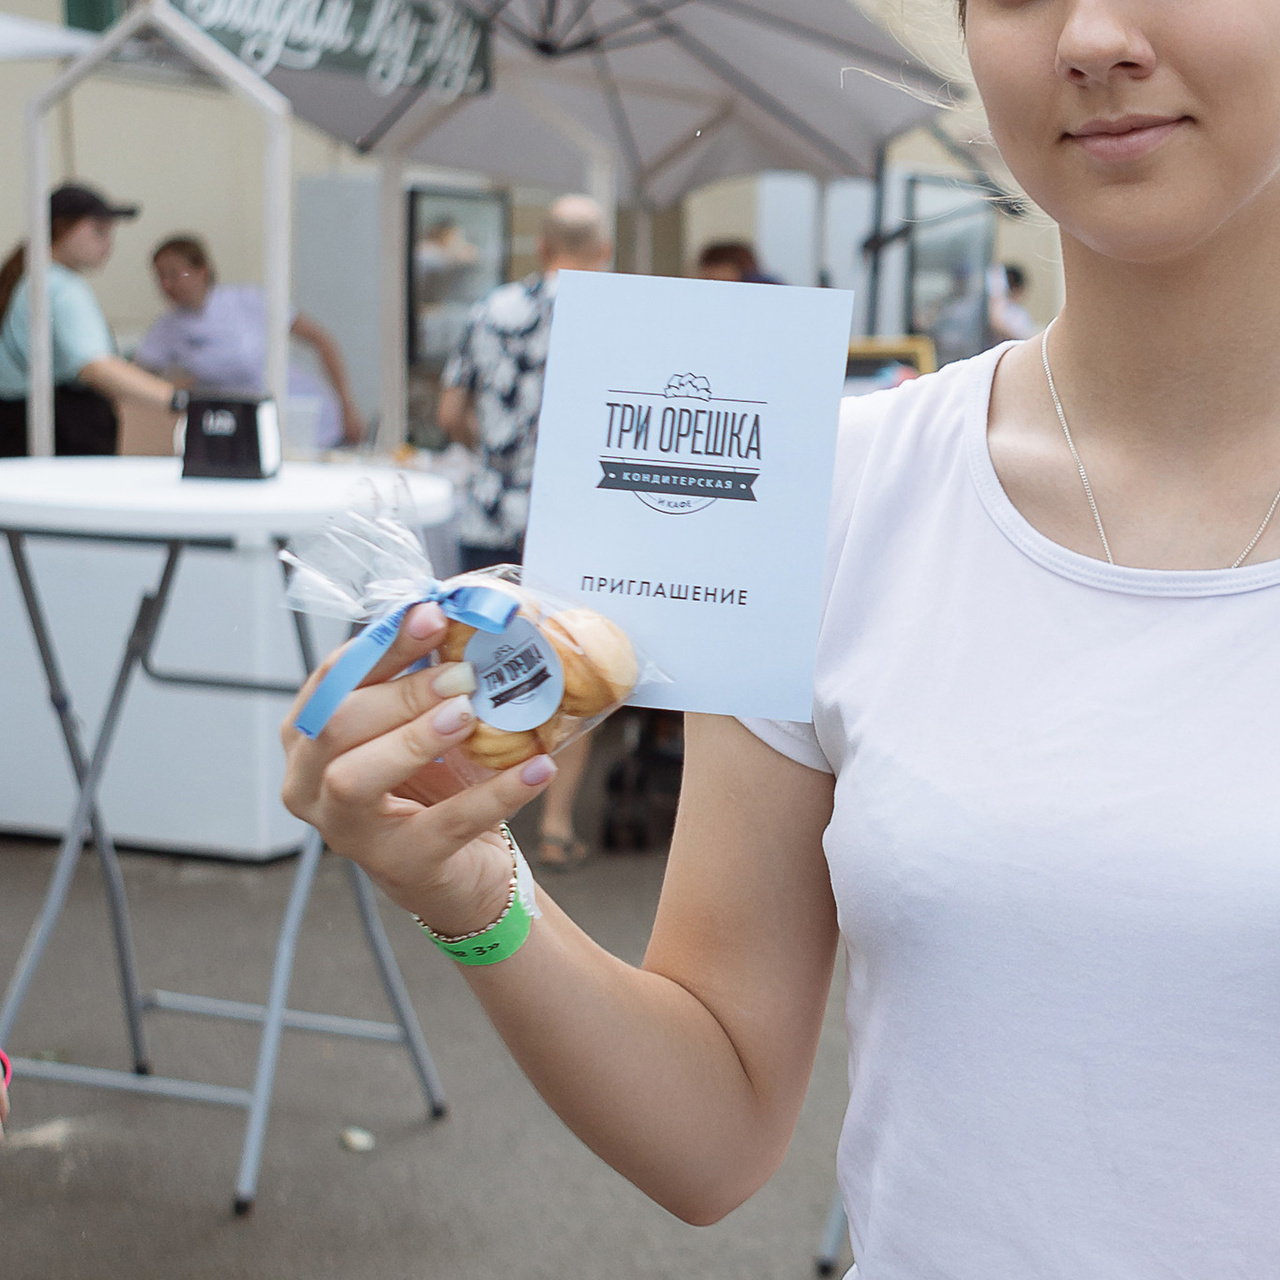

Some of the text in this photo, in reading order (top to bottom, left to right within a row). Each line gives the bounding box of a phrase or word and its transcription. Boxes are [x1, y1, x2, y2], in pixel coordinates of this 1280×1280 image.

[606, 402, 762, 460] ТРИ ОРЕШКА
[622, 471, 734, 490] КОНДИТЕРСКАЯ
[580, 575, 749, 607] ПРИГЛАШЕНИЕ
[483, 667, 507, 693] ТРИ
